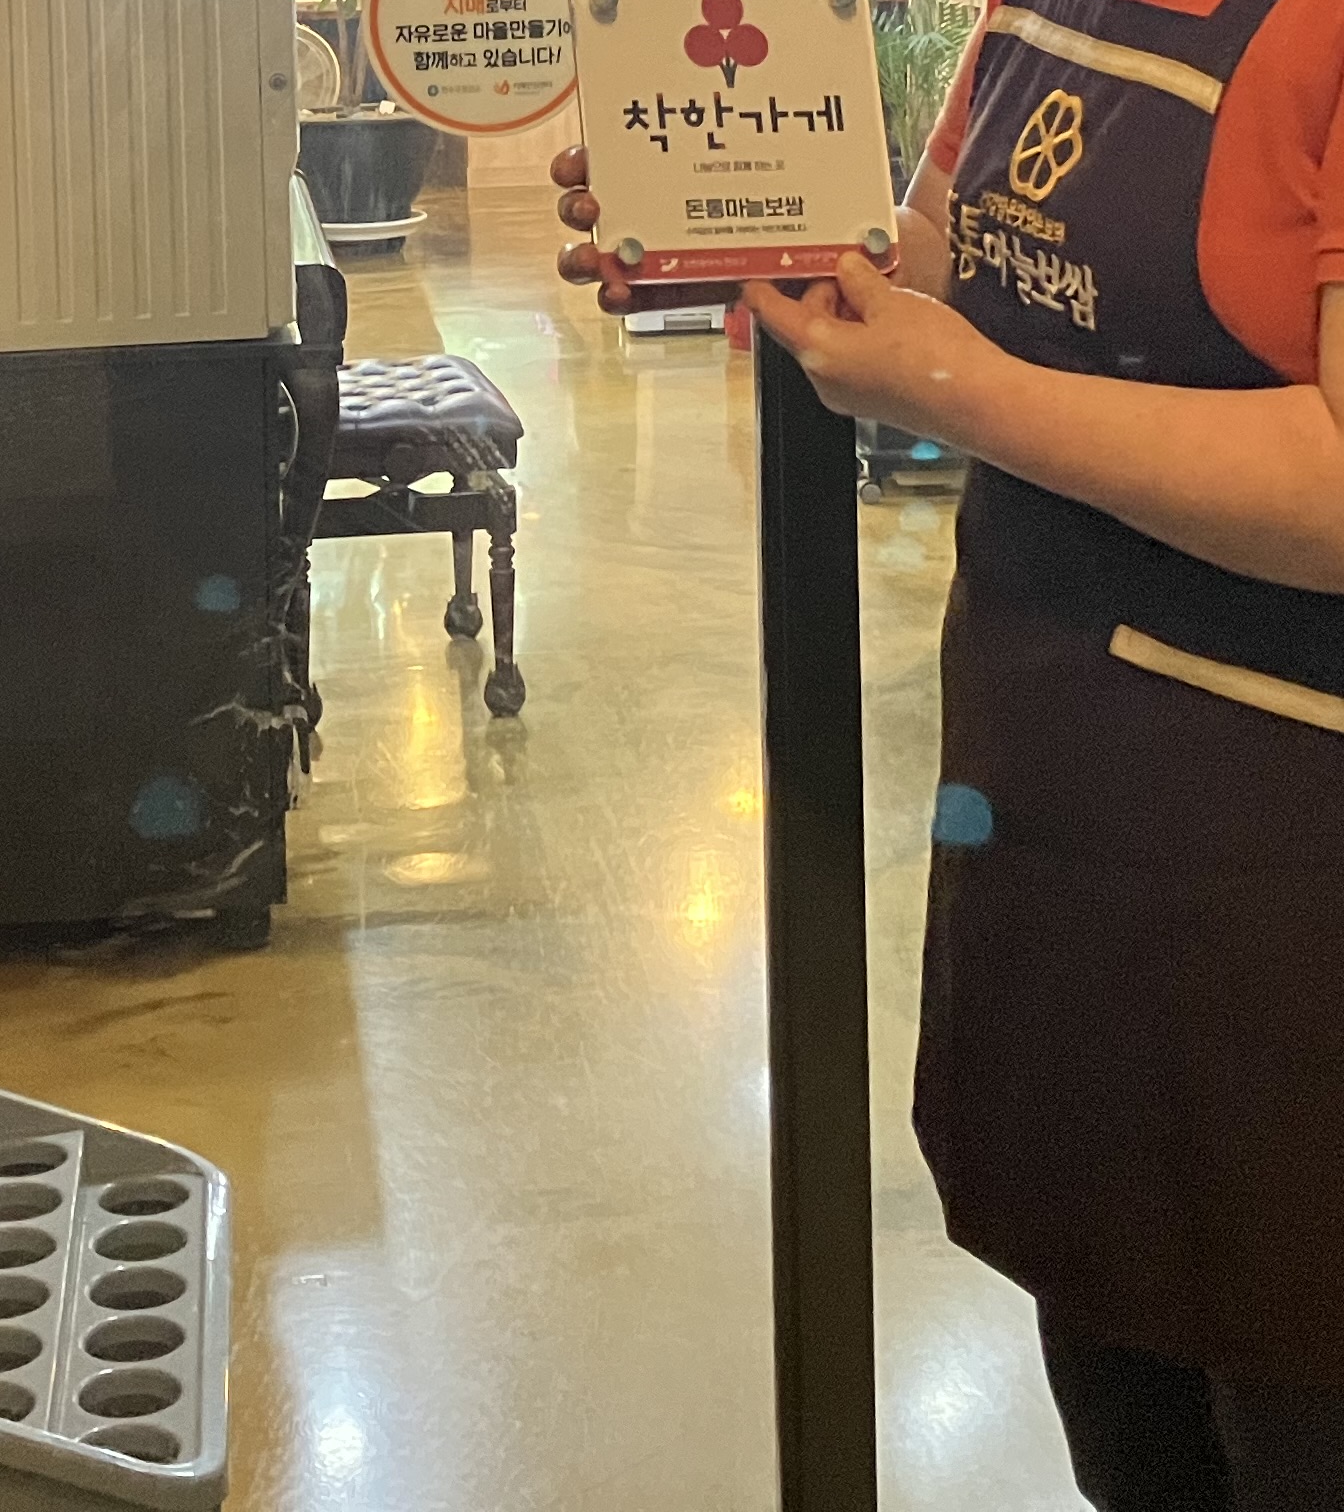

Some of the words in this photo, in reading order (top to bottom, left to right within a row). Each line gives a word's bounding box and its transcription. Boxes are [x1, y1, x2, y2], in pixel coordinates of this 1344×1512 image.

[395, 23, 468, 43] 자유로운
[413, 50, 477, 71] 함께하고
[483, 46, 562, 69] 있습니다!
[623, 92, 845, 153] 착한가게
[685, 196, 804, 220] 돈통마늘보쌈
